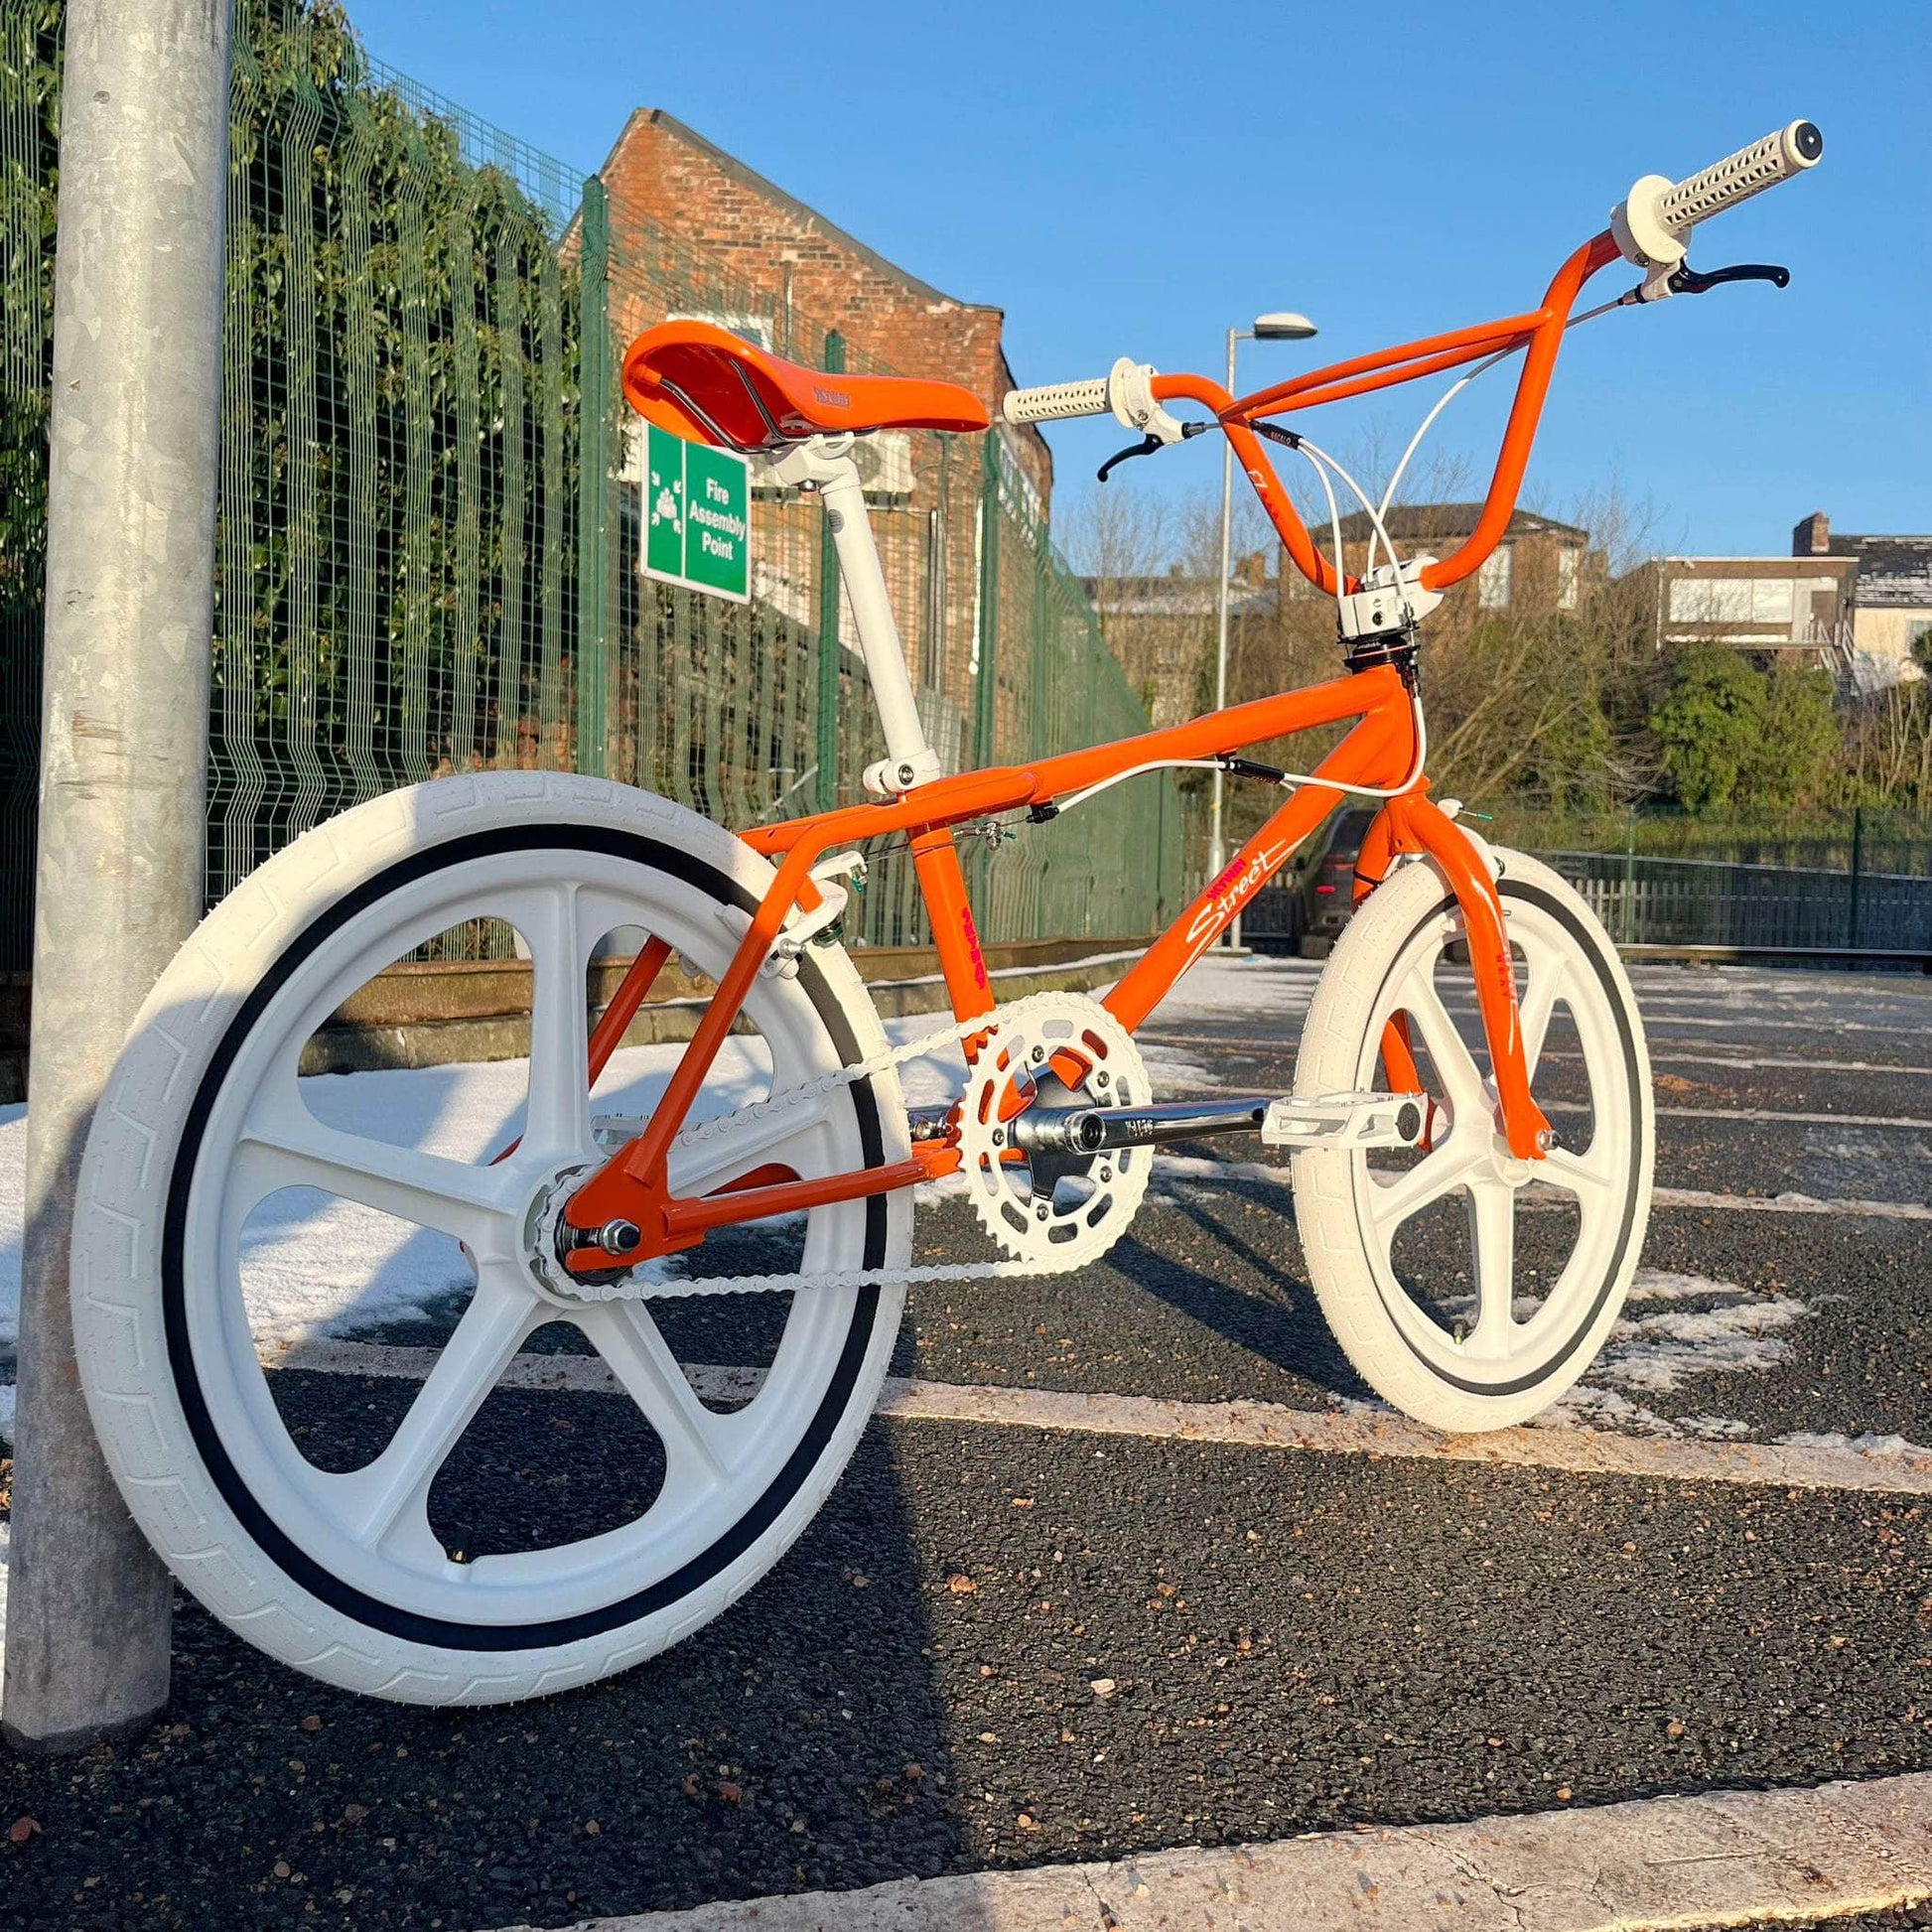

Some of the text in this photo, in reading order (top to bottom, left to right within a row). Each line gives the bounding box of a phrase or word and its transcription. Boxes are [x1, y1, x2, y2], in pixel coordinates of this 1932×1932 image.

[705, 478, 730, 505] Fire
[689, 499, 746, 542] Assembly
[701, 531, 734, 561] Point
[1179, 832, 1307, 959] Street
